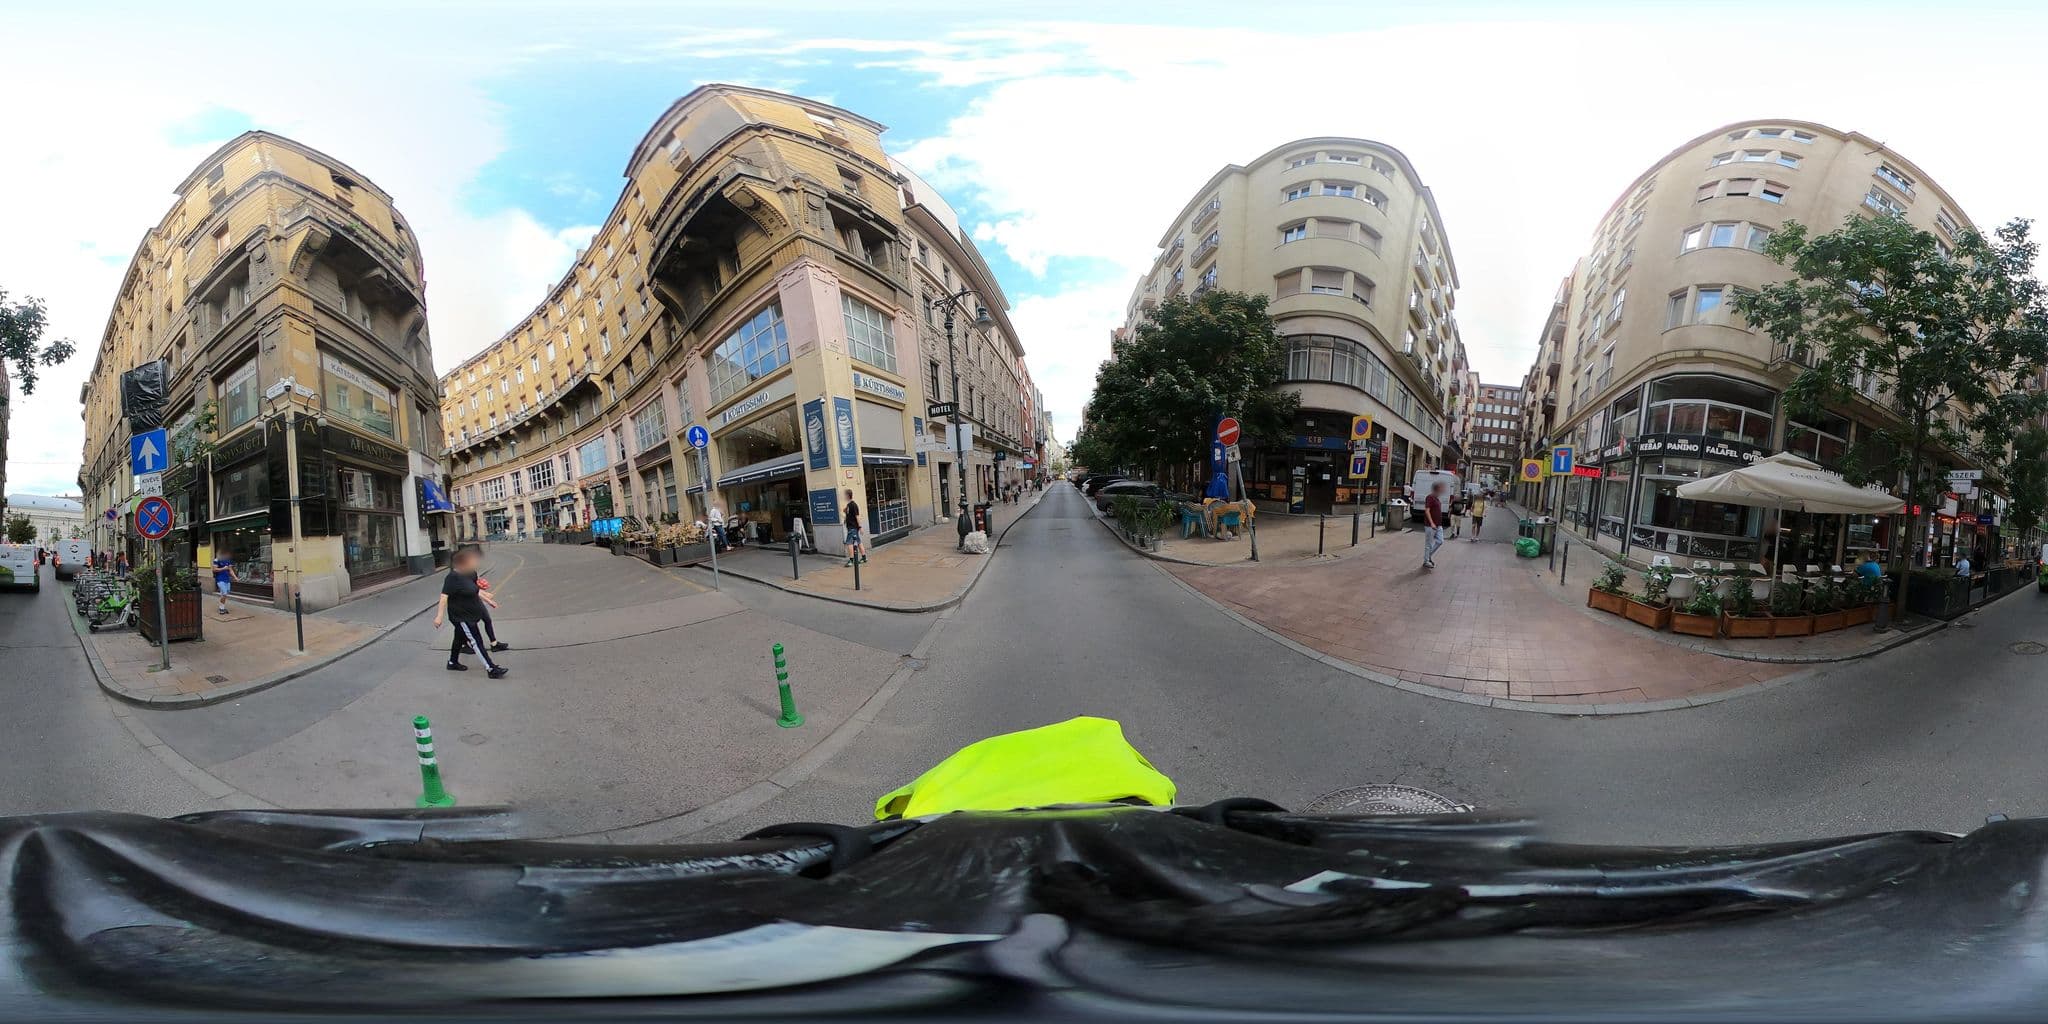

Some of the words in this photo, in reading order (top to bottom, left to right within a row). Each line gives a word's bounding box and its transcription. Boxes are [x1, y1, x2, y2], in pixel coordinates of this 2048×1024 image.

[931, 404, 951, 415] HOTEL
[302, 420, 318, 435] A
[1640, 442, 1663, 451] KEBAP
[1666, 442, 1699, 452] PANINO
[1705, 445, 1739, 458] FALAFEL
[1742, 452, 1765, 462] GYRO
